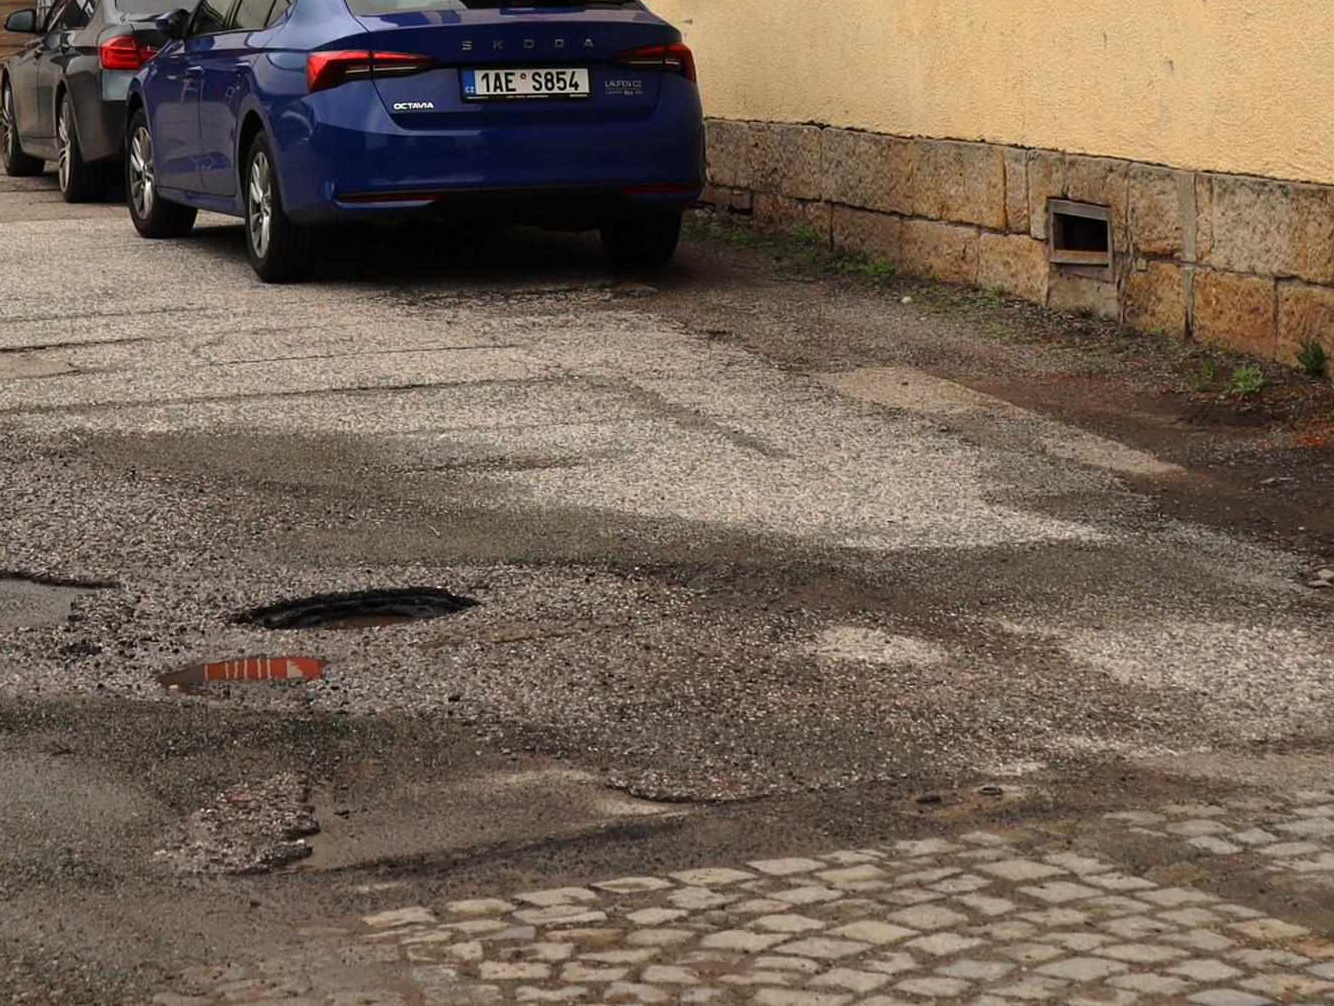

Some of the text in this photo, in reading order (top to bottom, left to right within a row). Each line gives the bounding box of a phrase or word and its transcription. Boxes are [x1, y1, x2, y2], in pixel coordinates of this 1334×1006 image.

[481, 70, 580, 92] 1AE S854
[393, 101, 435, 110] OCTAVIA
